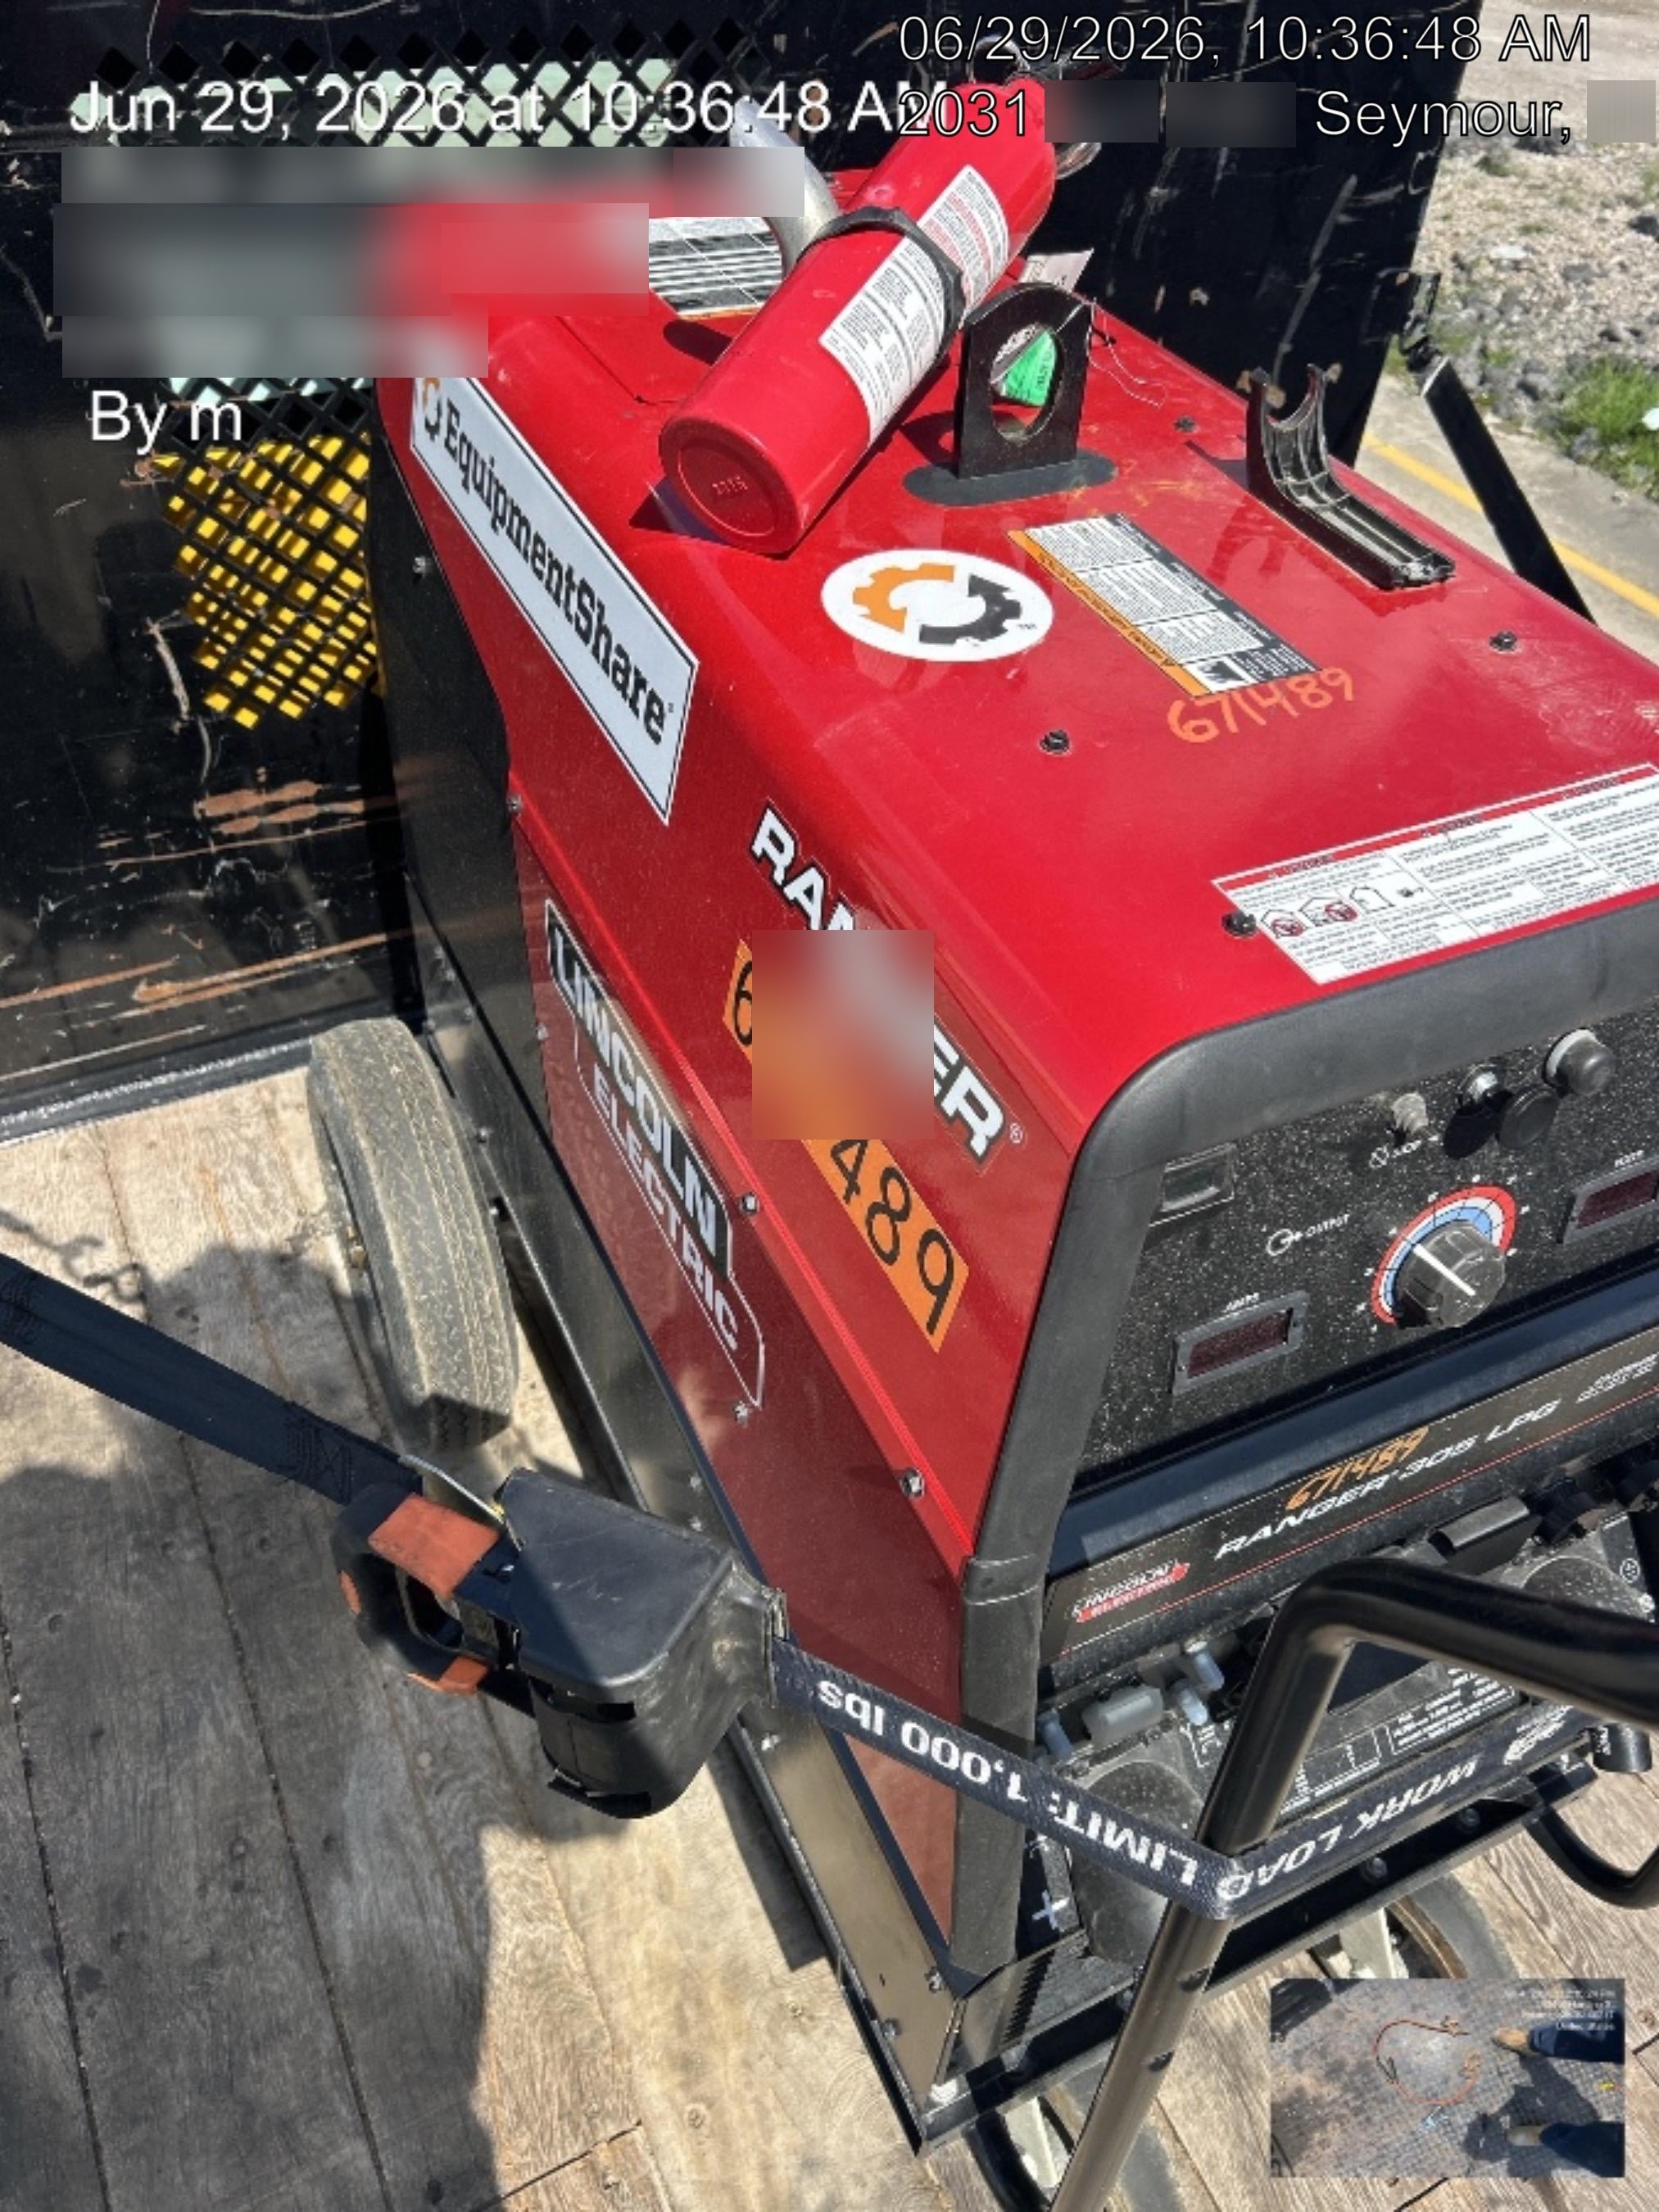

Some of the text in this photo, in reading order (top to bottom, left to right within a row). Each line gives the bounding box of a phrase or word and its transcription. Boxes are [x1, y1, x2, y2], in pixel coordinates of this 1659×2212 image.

[444, 399, 666, 745] EquipmentShare
[1167, 666, 1354, 743] 671489
[555, 927, 716, 1257] LINCOLN
[593, 1062, 738, 1352] ELECTRIC
[1214, 1472, 1393, 1561] RANGER
[1484, 1398, 1562, 1443] LPG
[818, 1676, 886, 1737] lbs
[901, 1719, 1029, 1804] 1,000
[1349, 1755, 1481, 1840] WORK
[1048, 1791, 1199, 1887] LIMIT:
